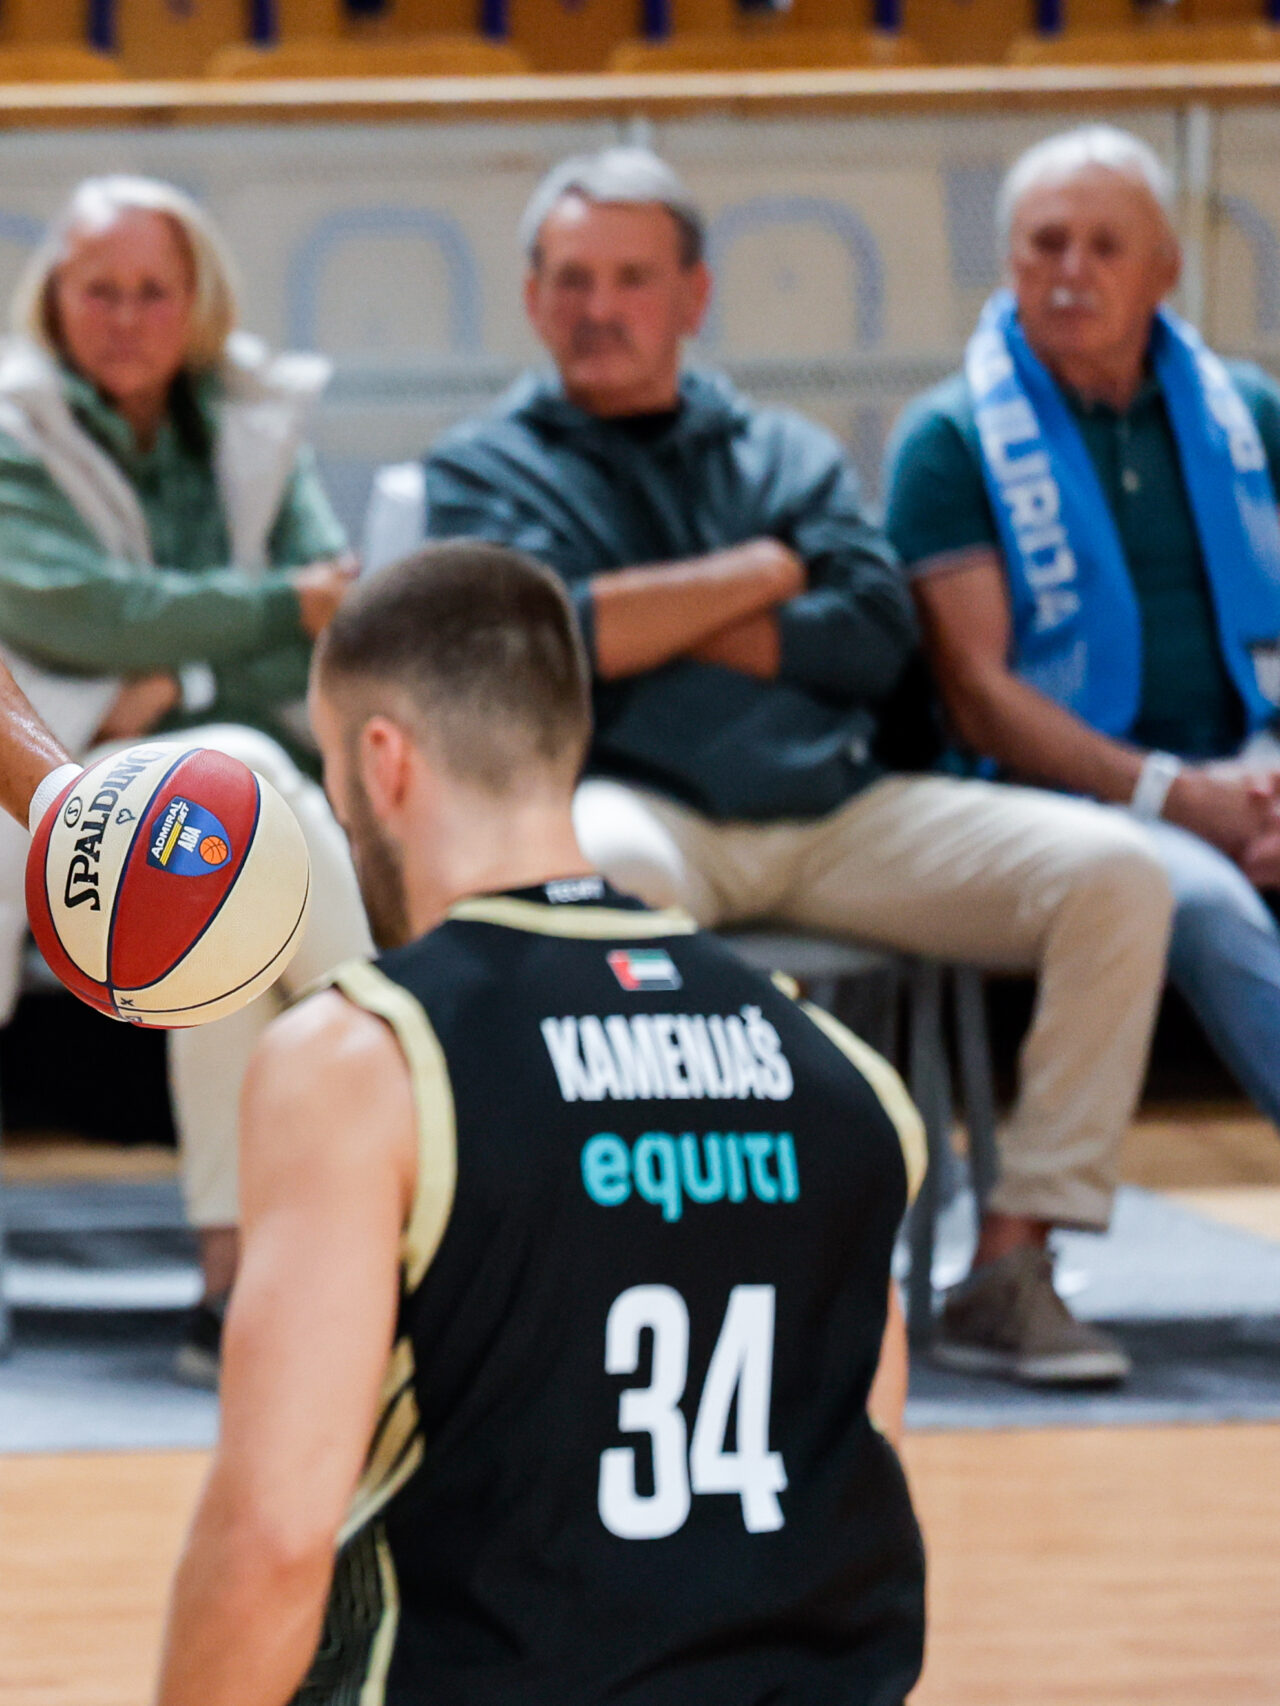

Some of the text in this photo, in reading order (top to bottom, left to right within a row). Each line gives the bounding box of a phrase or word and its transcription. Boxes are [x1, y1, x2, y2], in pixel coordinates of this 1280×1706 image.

[64, 749, 169, 912] SPALDING
[151, 801, 184, 859] ADMIRAL
[177, 825, 202, 853] ABA
[540, 1005, 794, 1102] KAMENJAŠ
[598, 1283, 788, 1541] 34
